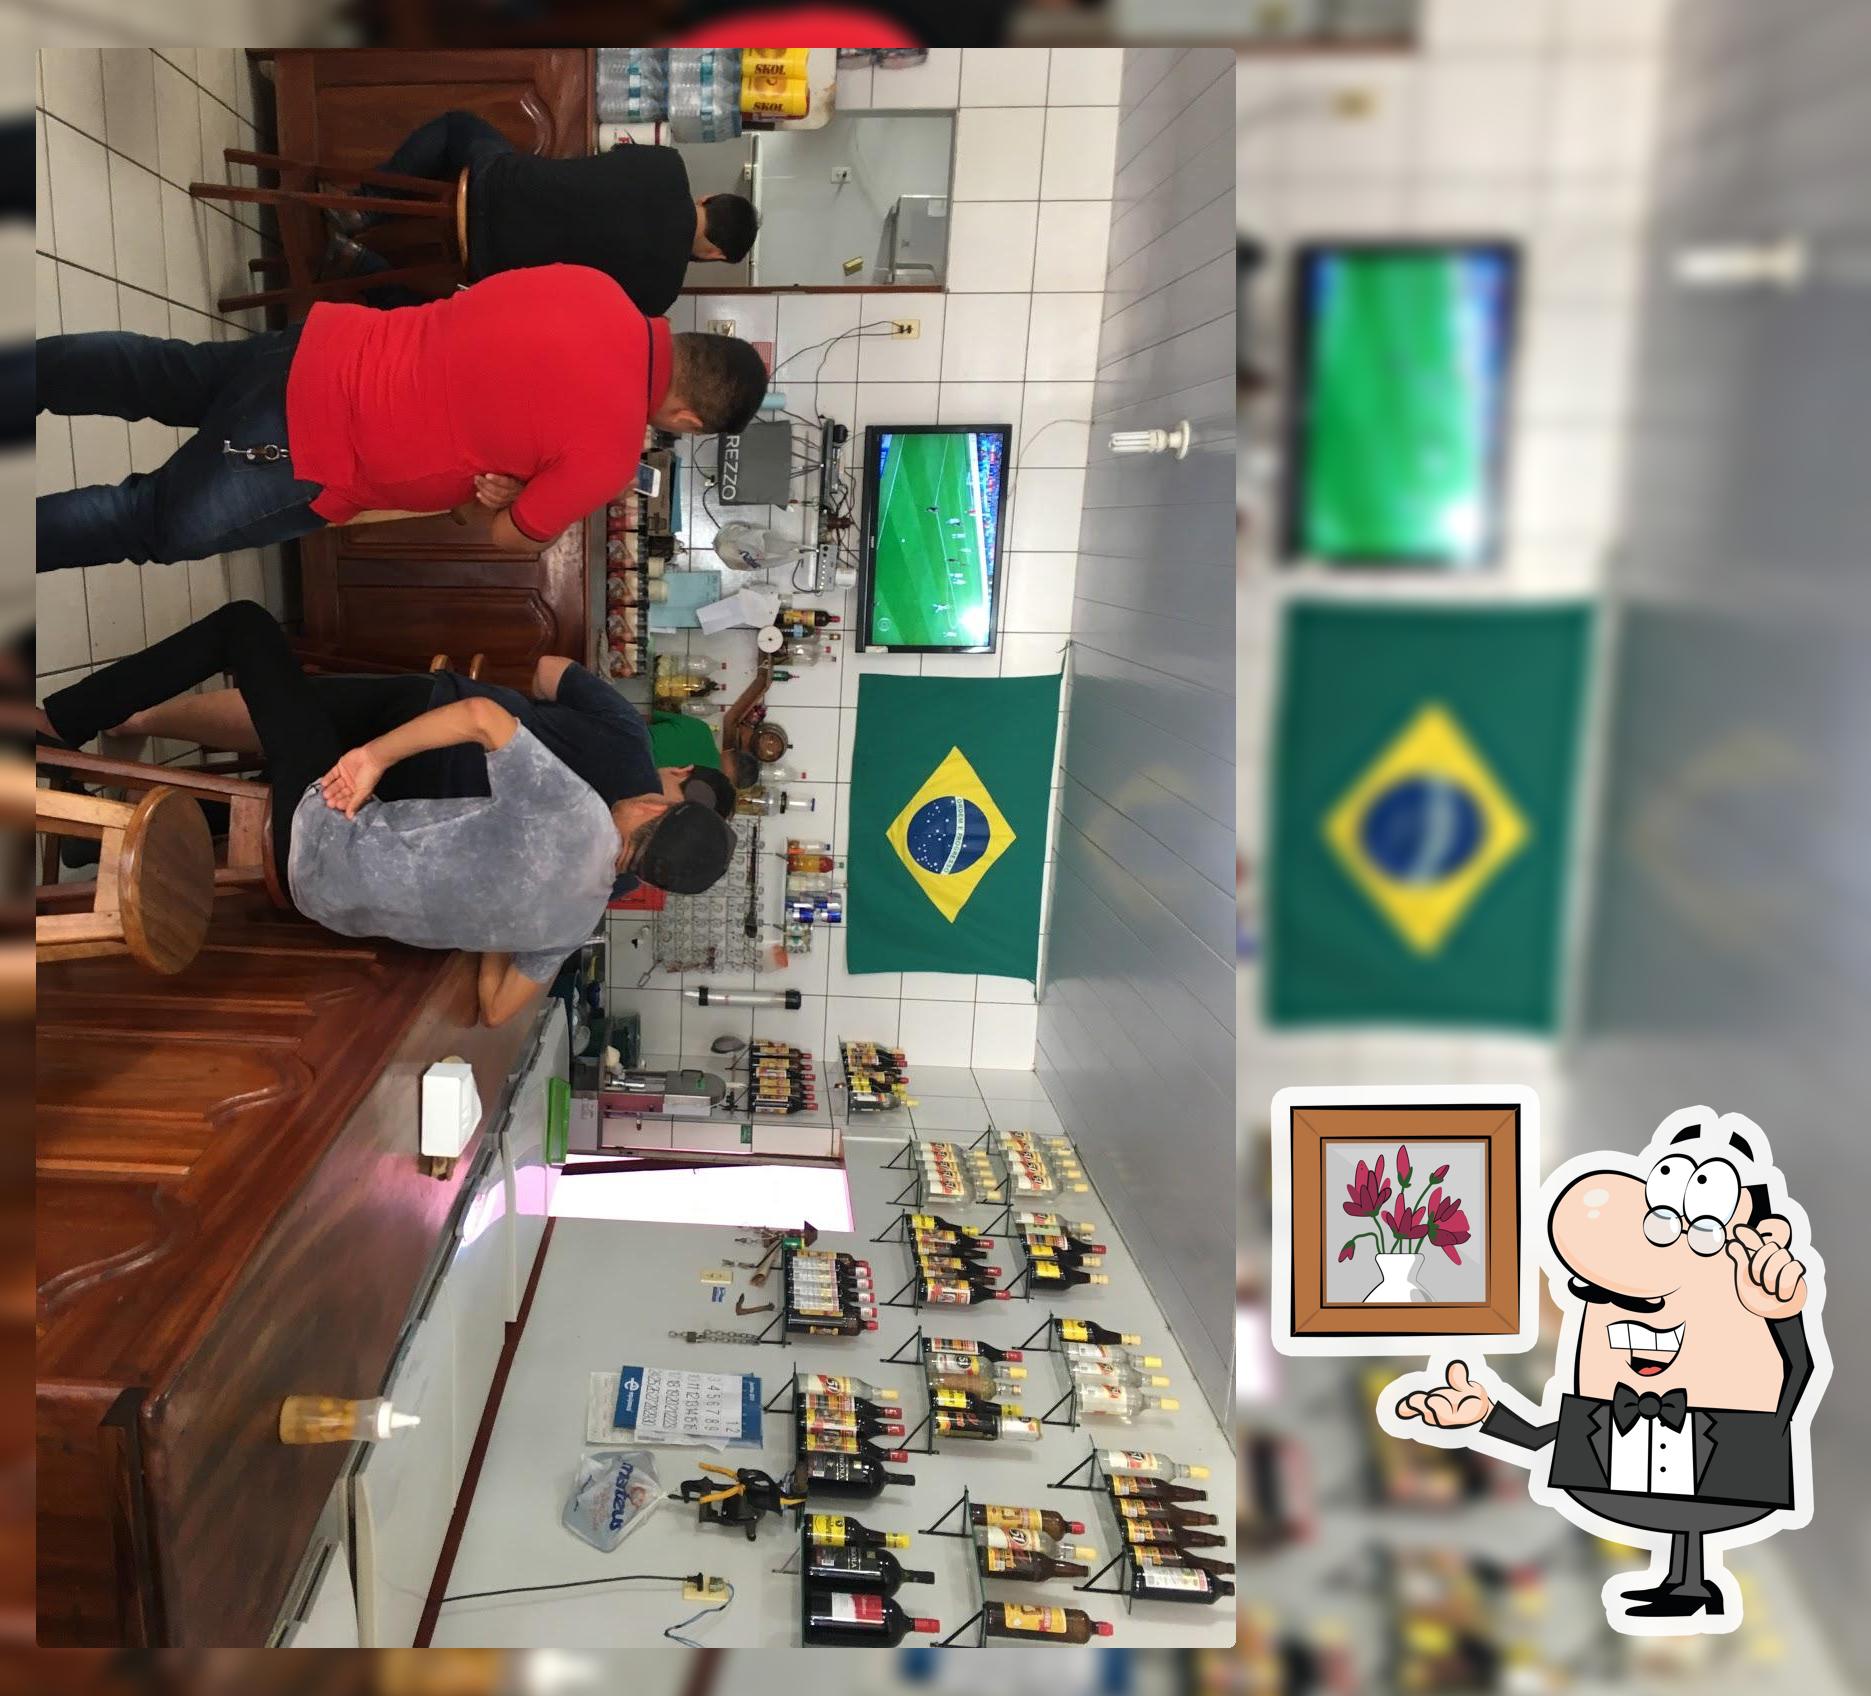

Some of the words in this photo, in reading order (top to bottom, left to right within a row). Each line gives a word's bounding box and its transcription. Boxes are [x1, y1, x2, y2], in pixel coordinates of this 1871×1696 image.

[754, 63, 786, 75] SKOL
[752, 101, 784, 112] SKOL
[956, 798, 965, 824] ORDEM
[942, 832, 963, 874] PROGRESSO
[825, 1379, 840, 1391] 51
[685, 1391, 700, 1400] 12
[609, 1462, 634, 1531] mateus
[1009, 1529, 1027, 1544] 51
